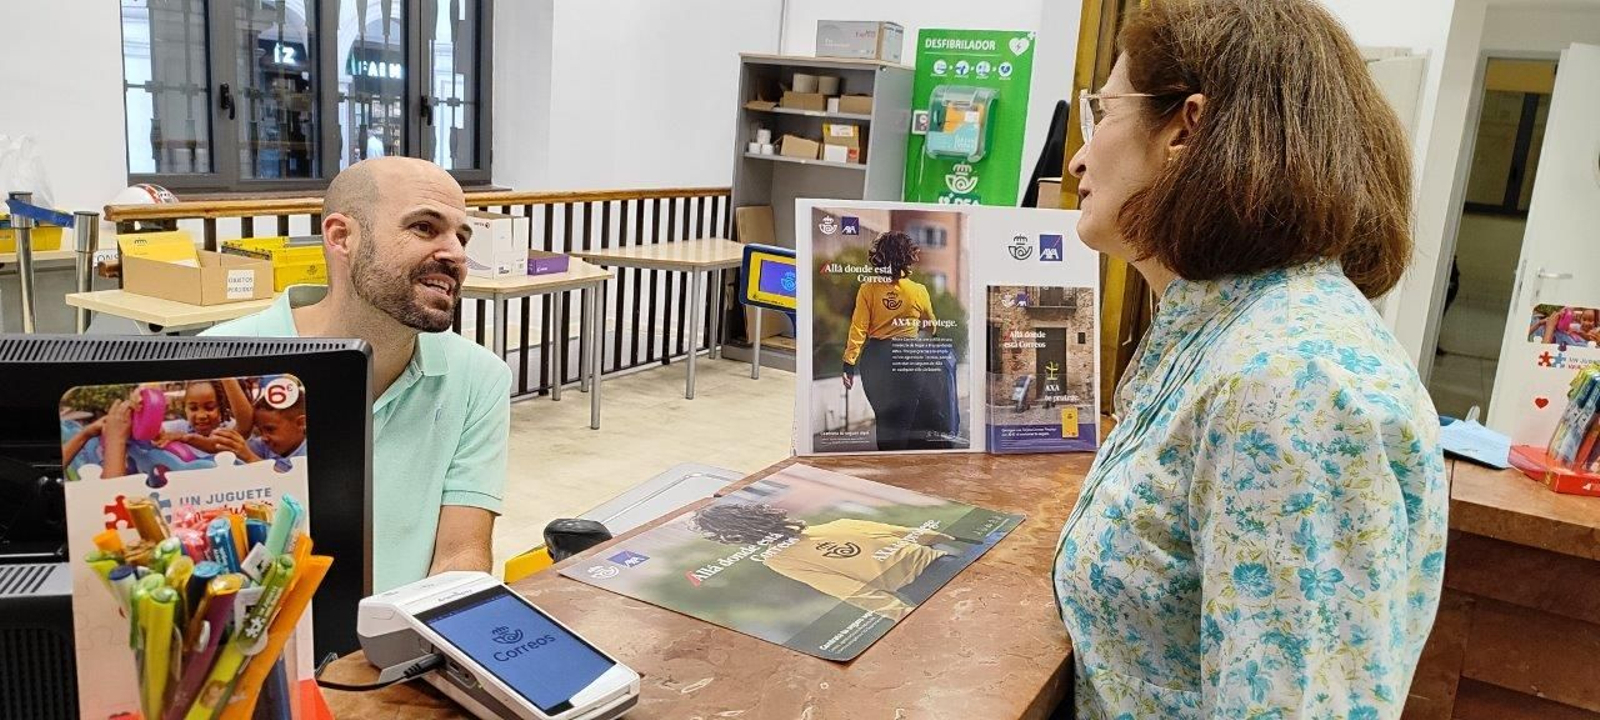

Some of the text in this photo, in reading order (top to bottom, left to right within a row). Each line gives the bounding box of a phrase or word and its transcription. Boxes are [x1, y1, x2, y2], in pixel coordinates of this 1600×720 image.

[925, 38, 996, 51] DESFIBRILADOR
[841, 225, 858, 234] AXA
[1039, 248, 1060, 260] AXA
[825, 263, 892, 274] Allá donde está
[857, 274, 892, 283] Correos
[891, 318, 958, 328] AXA te protege.
[1009, 330, 1023, 338] Allá
[1044, 384, 1060, 392] AXA
[180, 487, 272, 505] UN JUGUETE
[750, 537, 800, 562] Correos
[872, 546, 898, 562] AXA
[690, 564, 724, 582] Allá
[718, 544, 761, 567] donde
[493, 634, 556, 661] Correos
